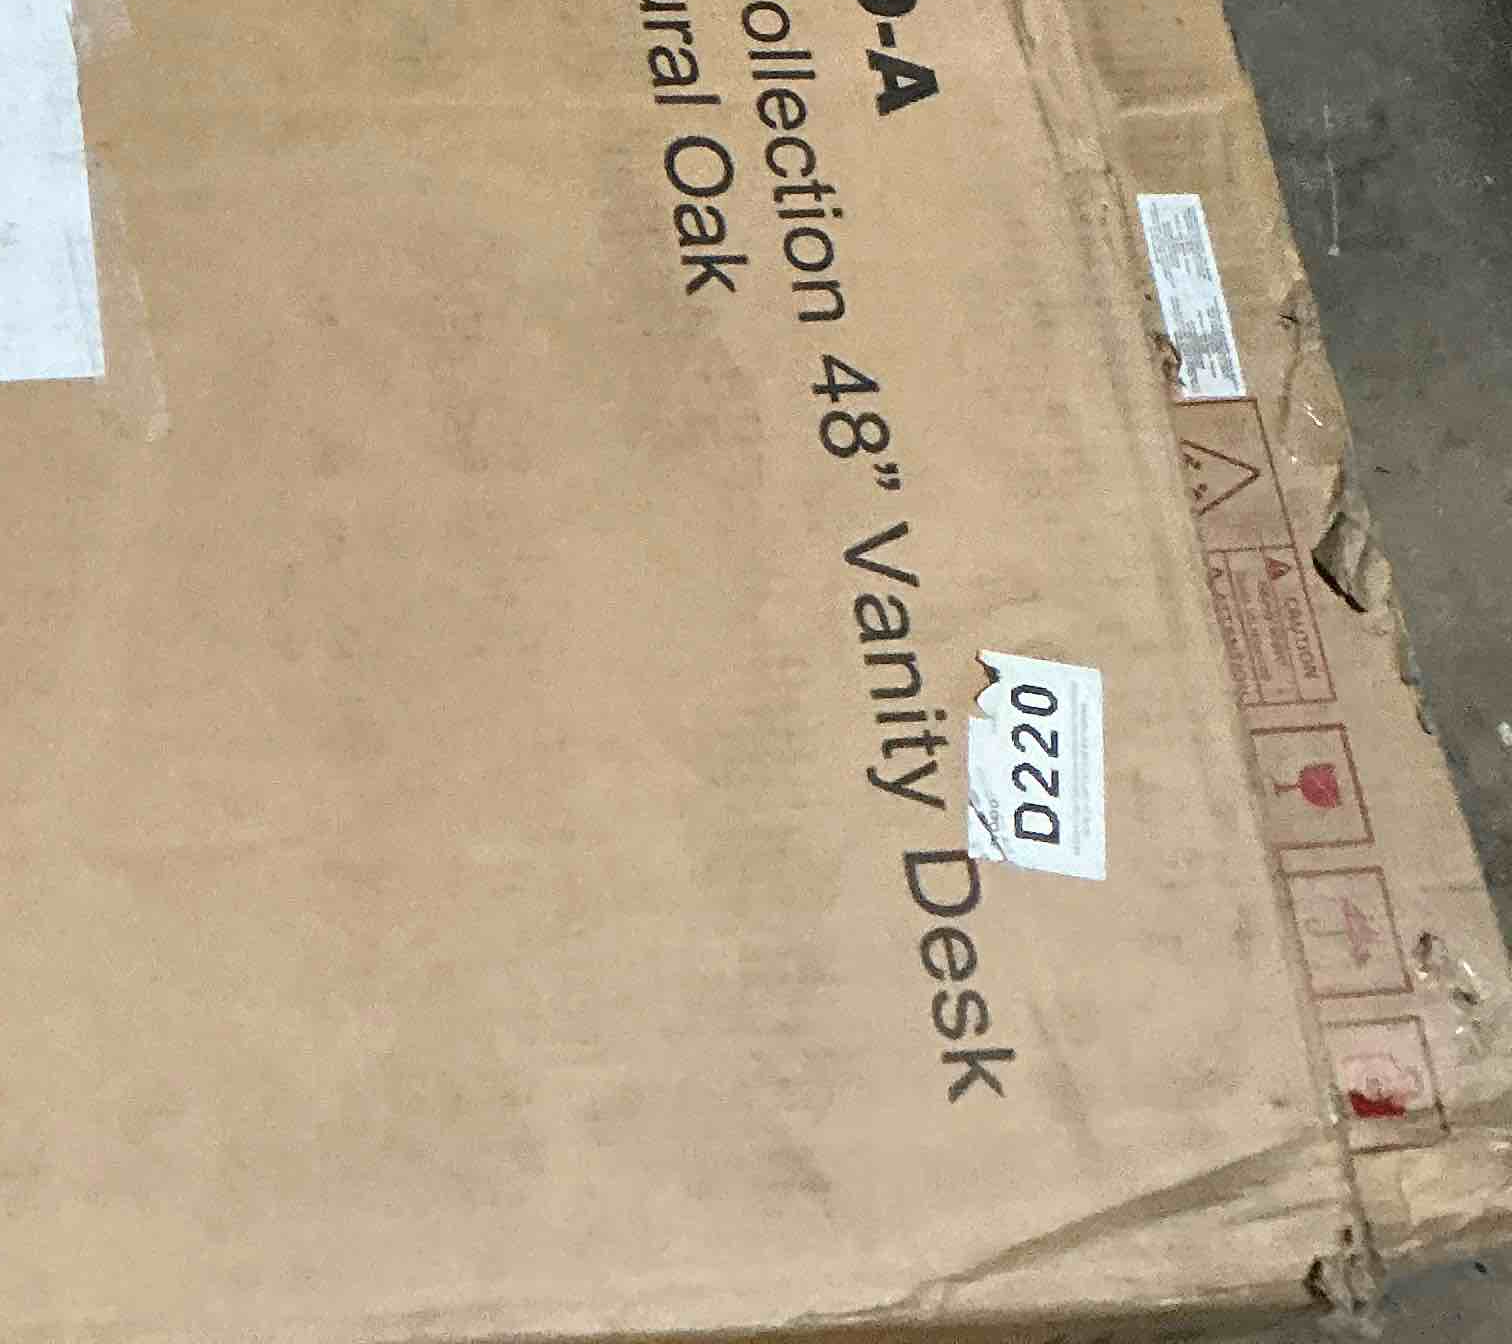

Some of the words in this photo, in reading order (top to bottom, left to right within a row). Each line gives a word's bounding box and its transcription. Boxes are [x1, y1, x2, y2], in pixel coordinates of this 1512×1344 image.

[663, 134, 749, 294] Oak
[843, 520, 952, 812] Vanity
[902, 848, 1016, 1103] Desk
[1011, 684, 1060, 845] D220
